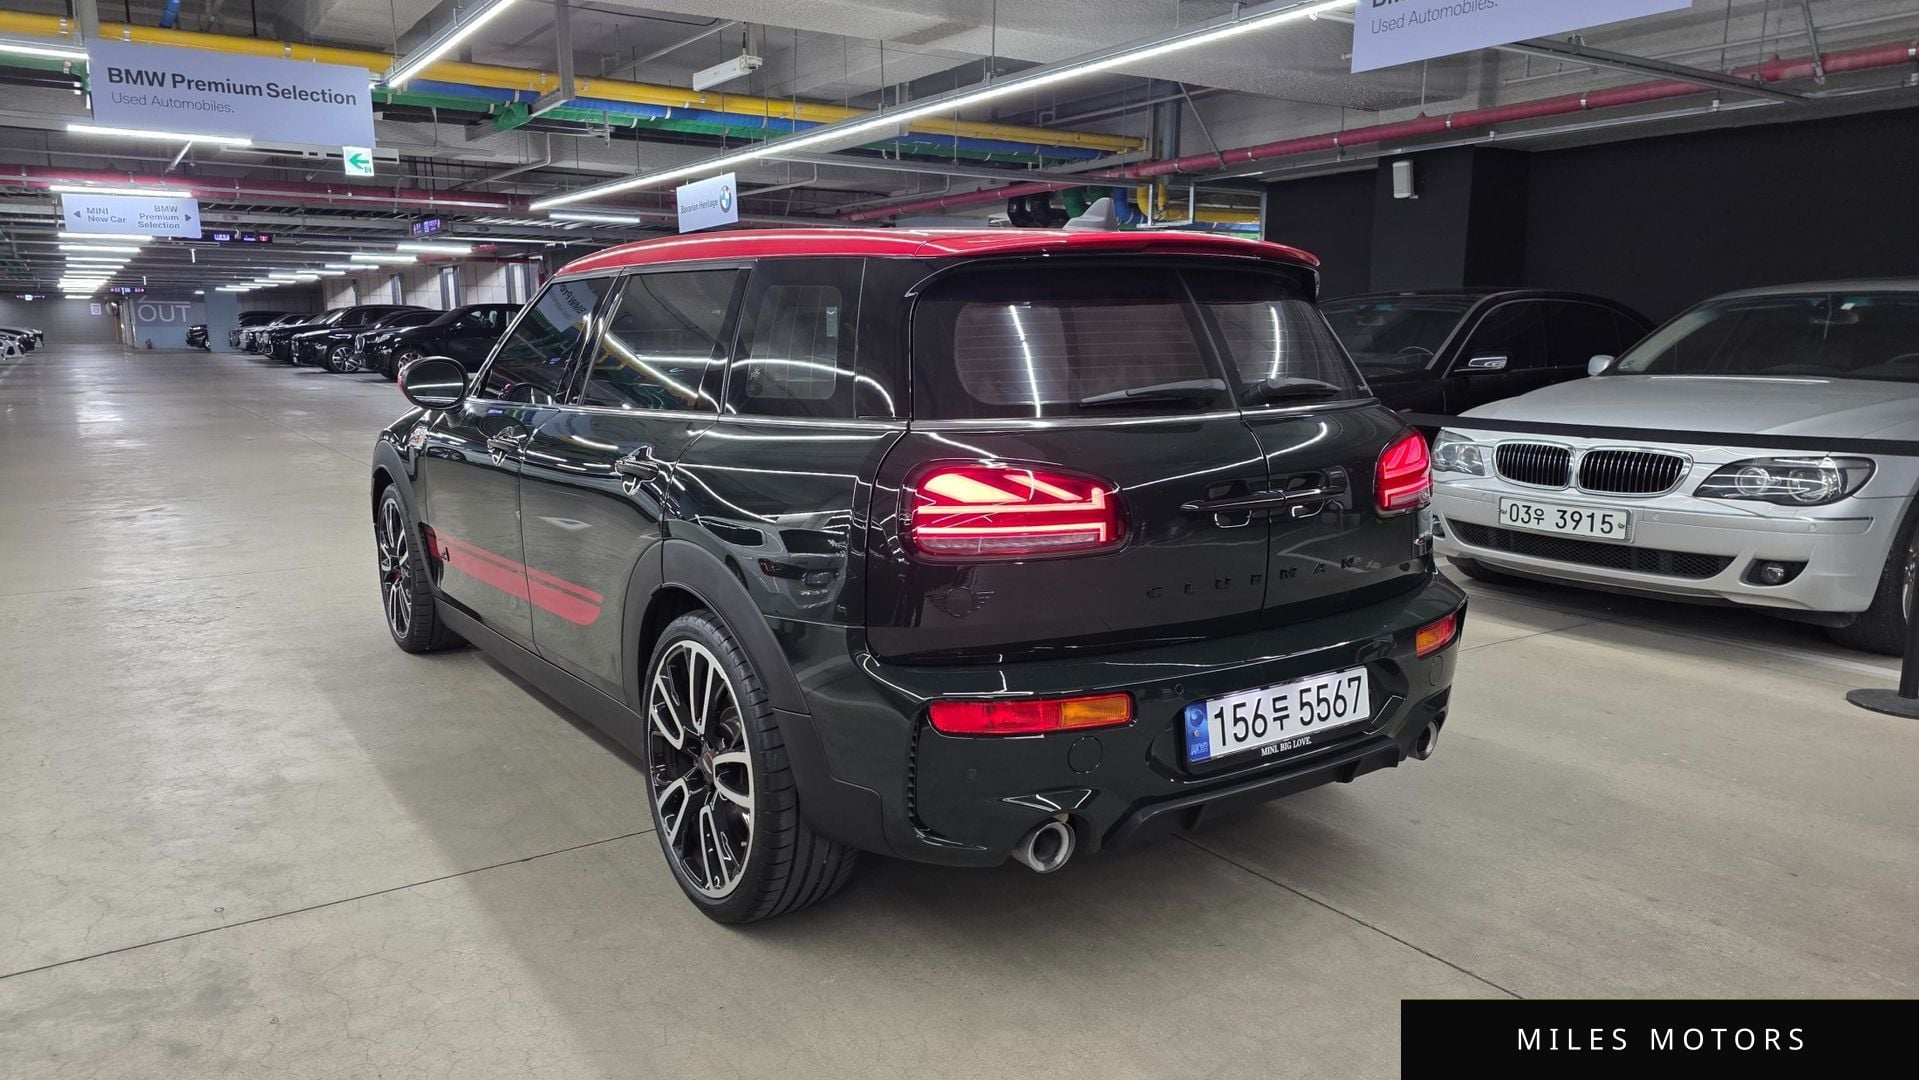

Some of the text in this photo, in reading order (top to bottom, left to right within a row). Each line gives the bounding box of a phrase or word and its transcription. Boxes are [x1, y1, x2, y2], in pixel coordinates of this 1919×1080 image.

[1371, 13, 1405, 34] Used
[107, 66, 357, 106] BMW Premium Selection
[111, 91, 234, 113] Used Automobiles.
[86, 207, 109, 215] MINI
[139, 212, 179, 221] Premium
[154, 205, 178, 213] BMW
[87, 214, 127, 223] New Car
[137, 220, 180, 229] Selection
[137, 304, 192, 323] OUT
[1509, 503, 1614, 535] 03우 3915
[1214, 675, 1362, 747] 156두 5567
[1280, 741, 1292, 752] BIG
